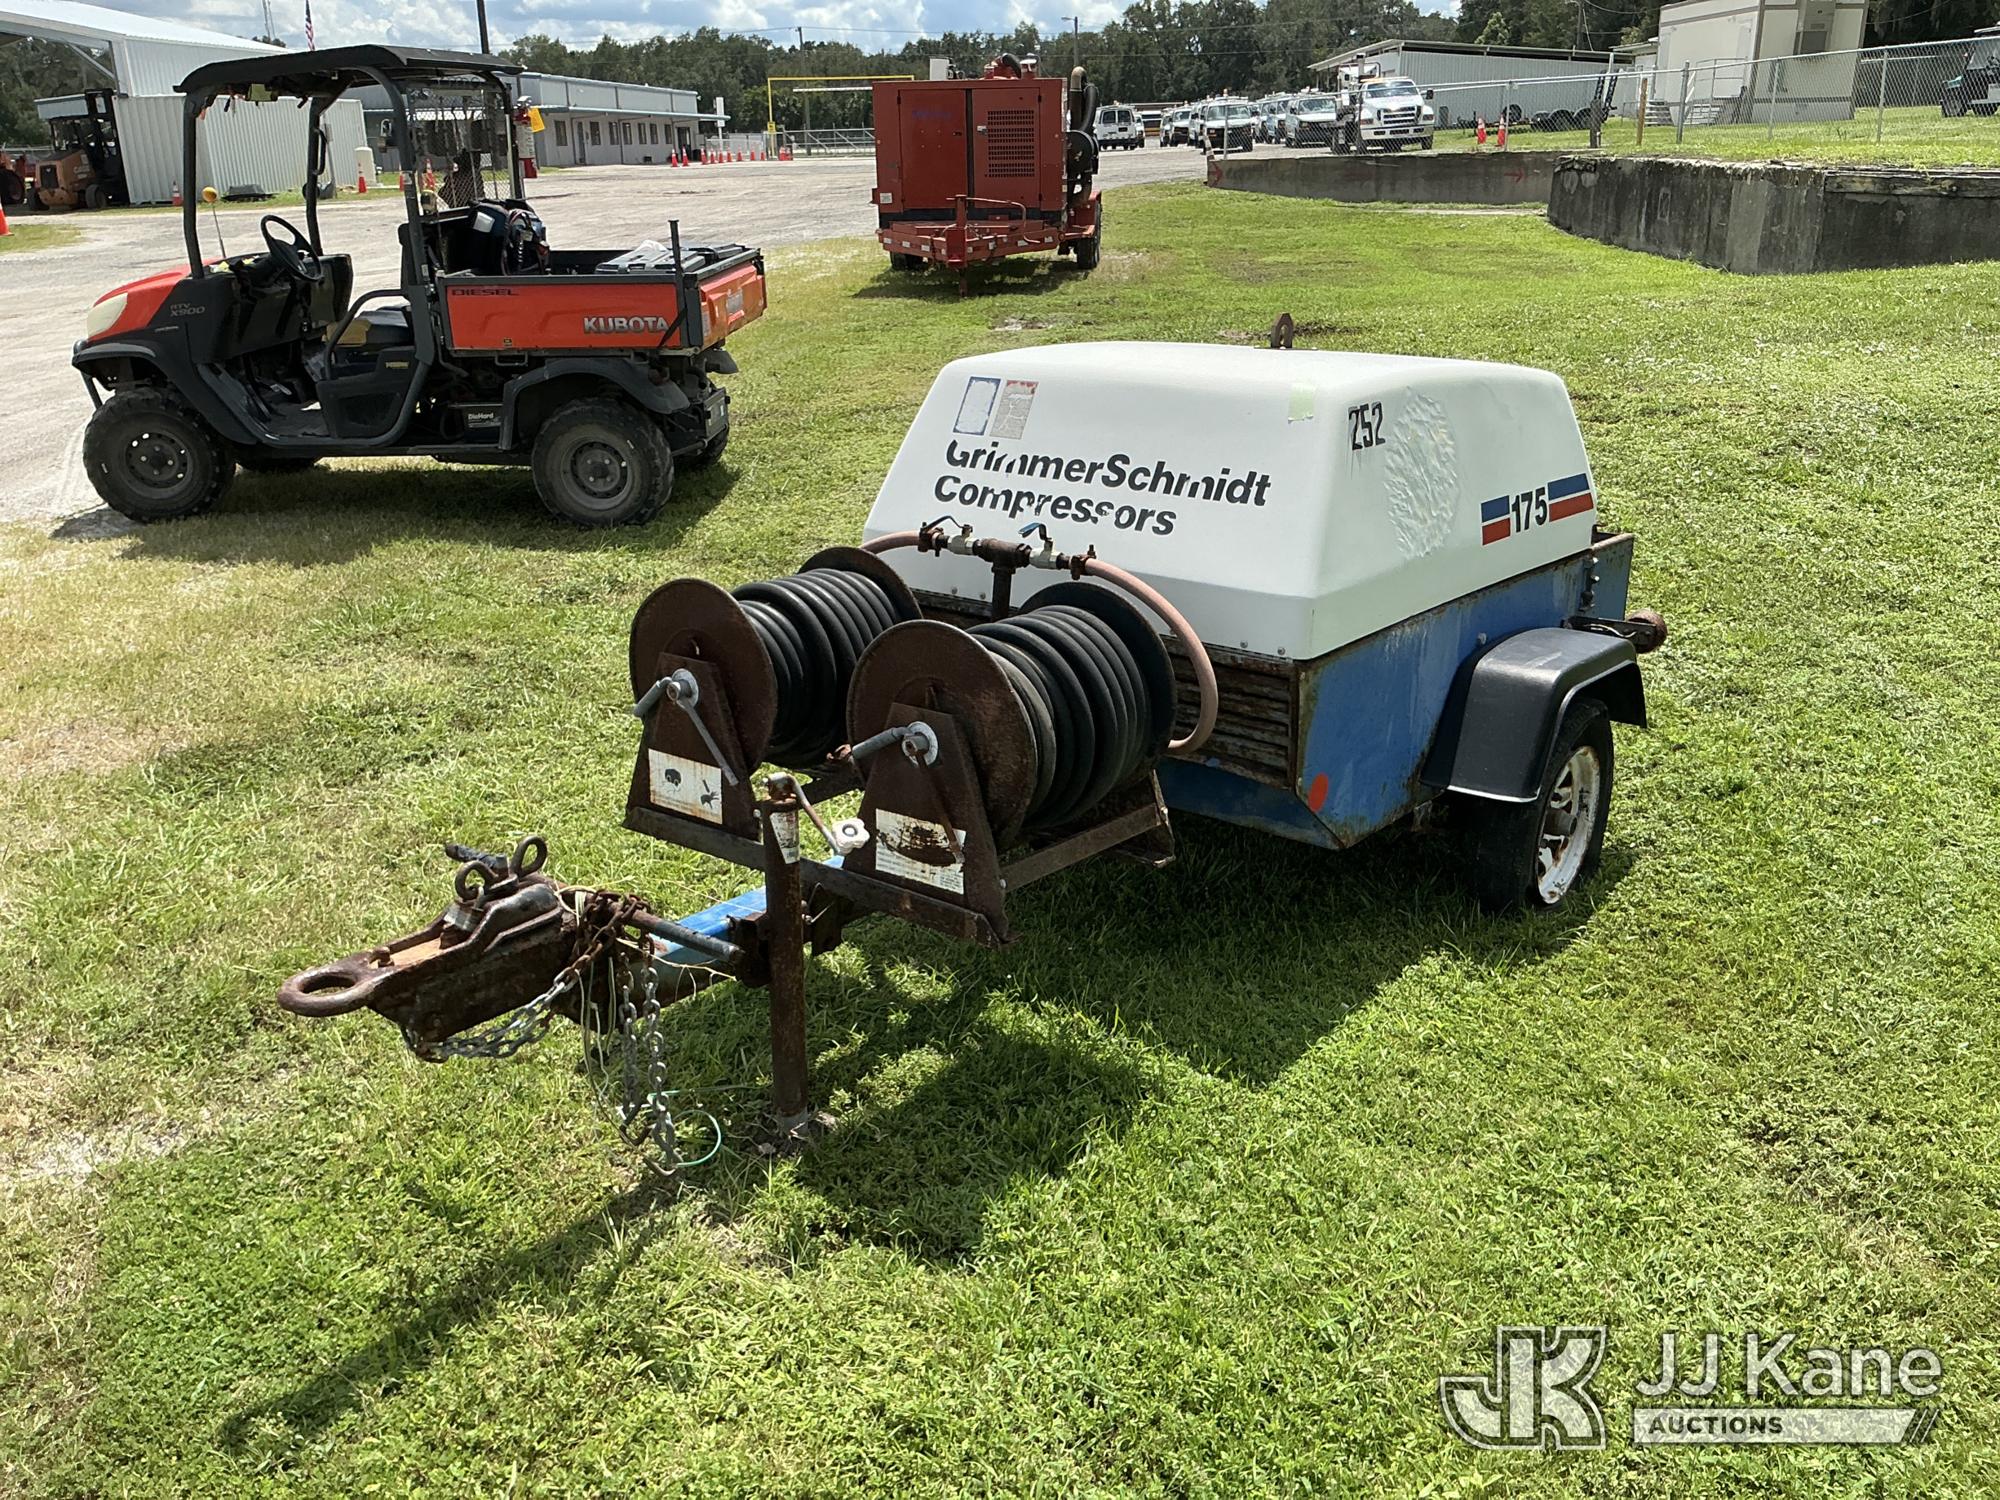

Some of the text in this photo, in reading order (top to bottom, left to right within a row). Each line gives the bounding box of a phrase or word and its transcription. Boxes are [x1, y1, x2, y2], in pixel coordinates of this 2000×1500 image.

[452, 288, 520, 296] DIESEL
[583, 316, 669, 334] KUBOTA
[1348, 401, 1386, 451] 252
[934, 475, 1177, 536] Compressors
[1511, 486, 1548, 533] 175
